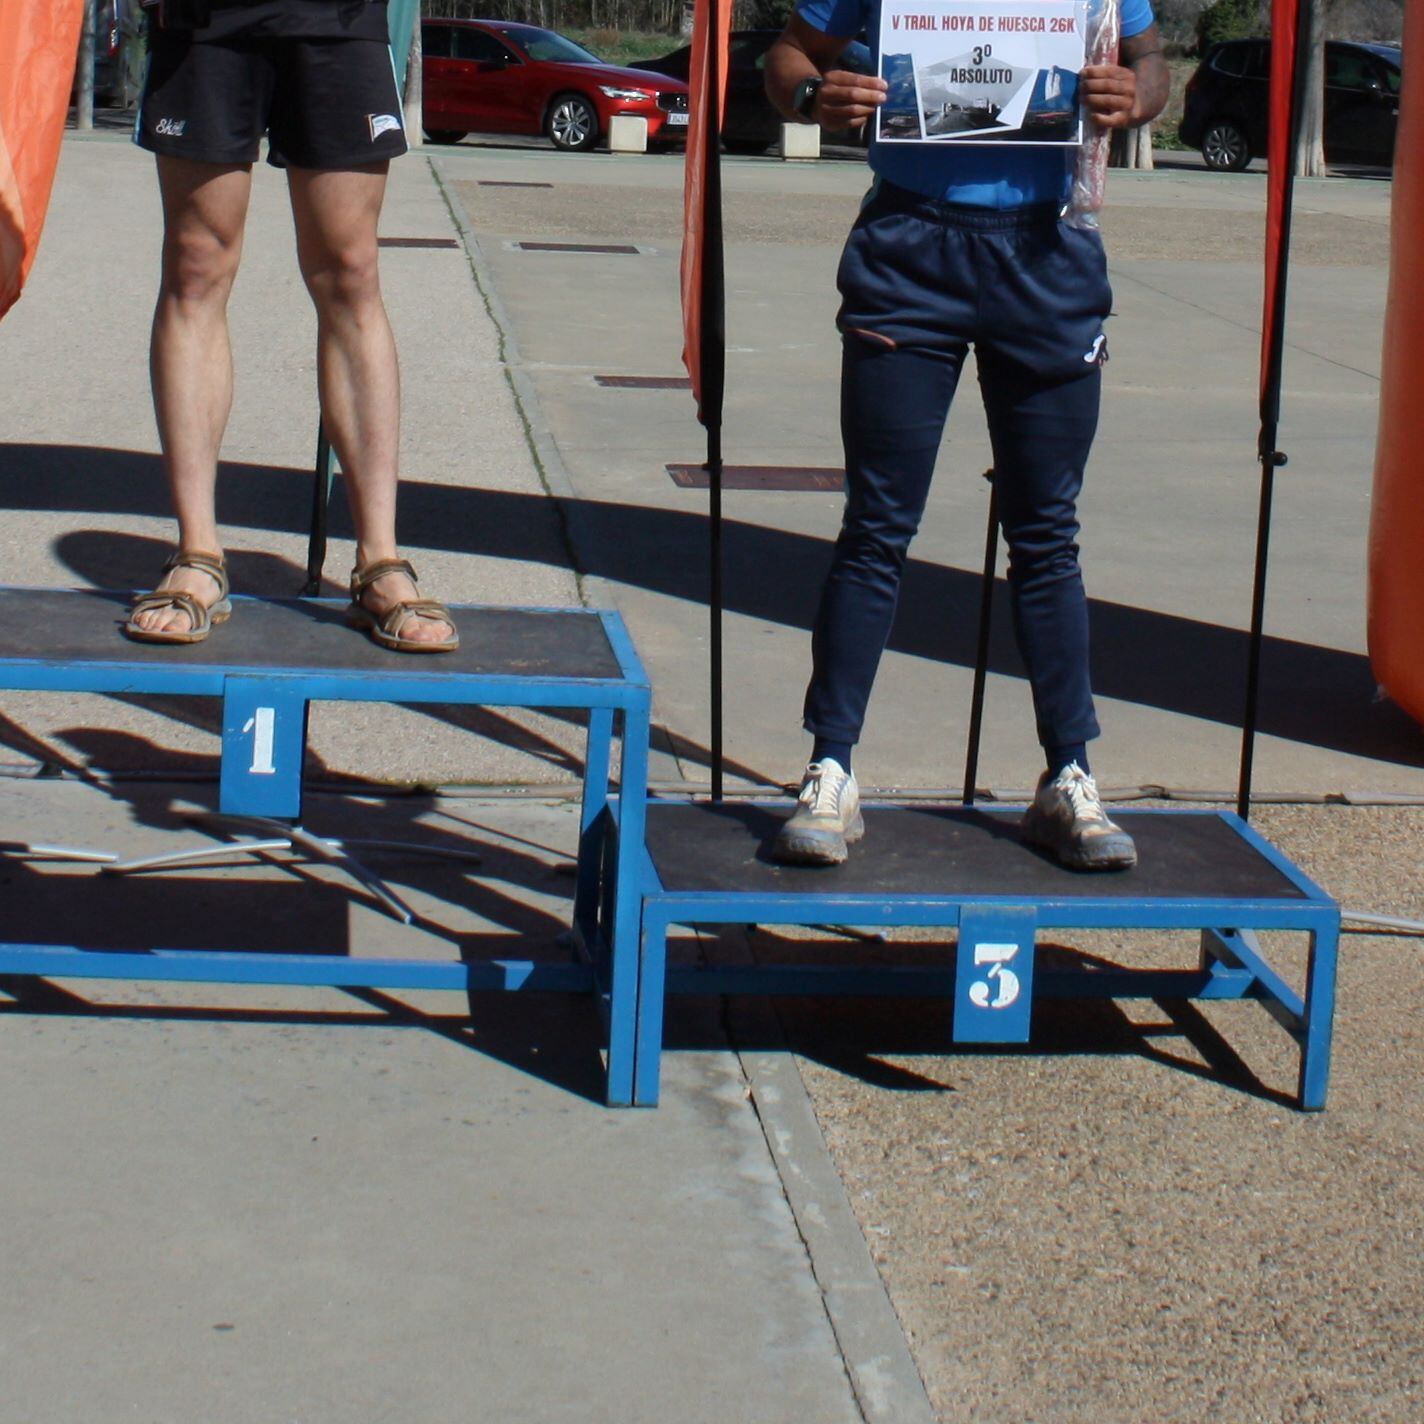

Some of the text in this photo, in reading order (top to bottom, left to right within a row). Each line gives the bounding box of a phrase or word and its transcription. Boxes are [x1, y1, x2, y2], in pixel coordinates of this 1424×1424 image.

[892, 15, 1075, 33] V TRAIL HOYA DE HUESCA 26K
[950, 68, 1012, 84] ABSOLUTO
[242, 707, 275, 774] 1
[969, 943, 1020, 1009] 3
